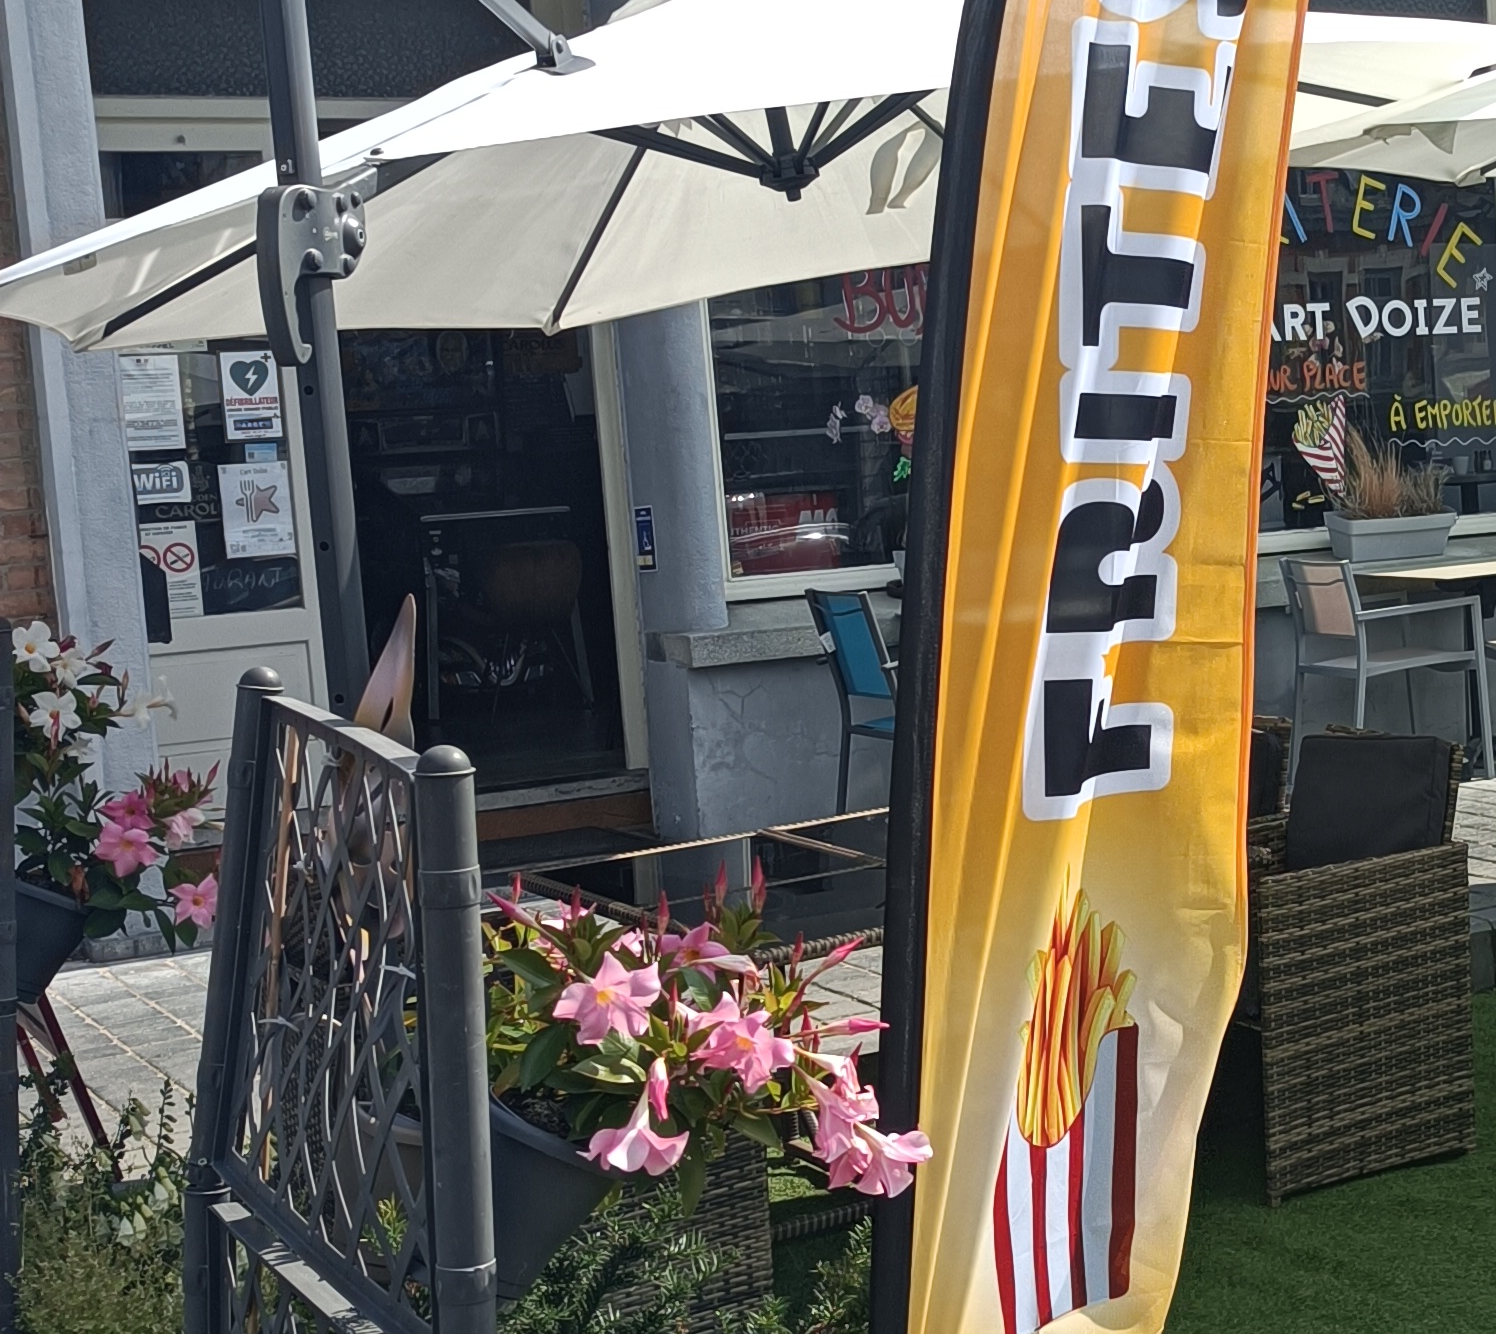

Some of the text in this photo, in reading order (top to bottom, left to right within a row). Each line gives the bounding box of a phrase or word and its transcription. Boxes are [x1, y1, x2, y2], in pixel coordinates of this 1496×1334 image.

[1280, 171, 1482, 289] ITERIE
[1346, 296, 1482, 339] DOIZE
[1268, 361, 1367, 393] UR PLACE
[1390, 394, 1407, 432] À
[133, 471, 178, 491] WiFi
[155, 502, 221, 522] CAROL
